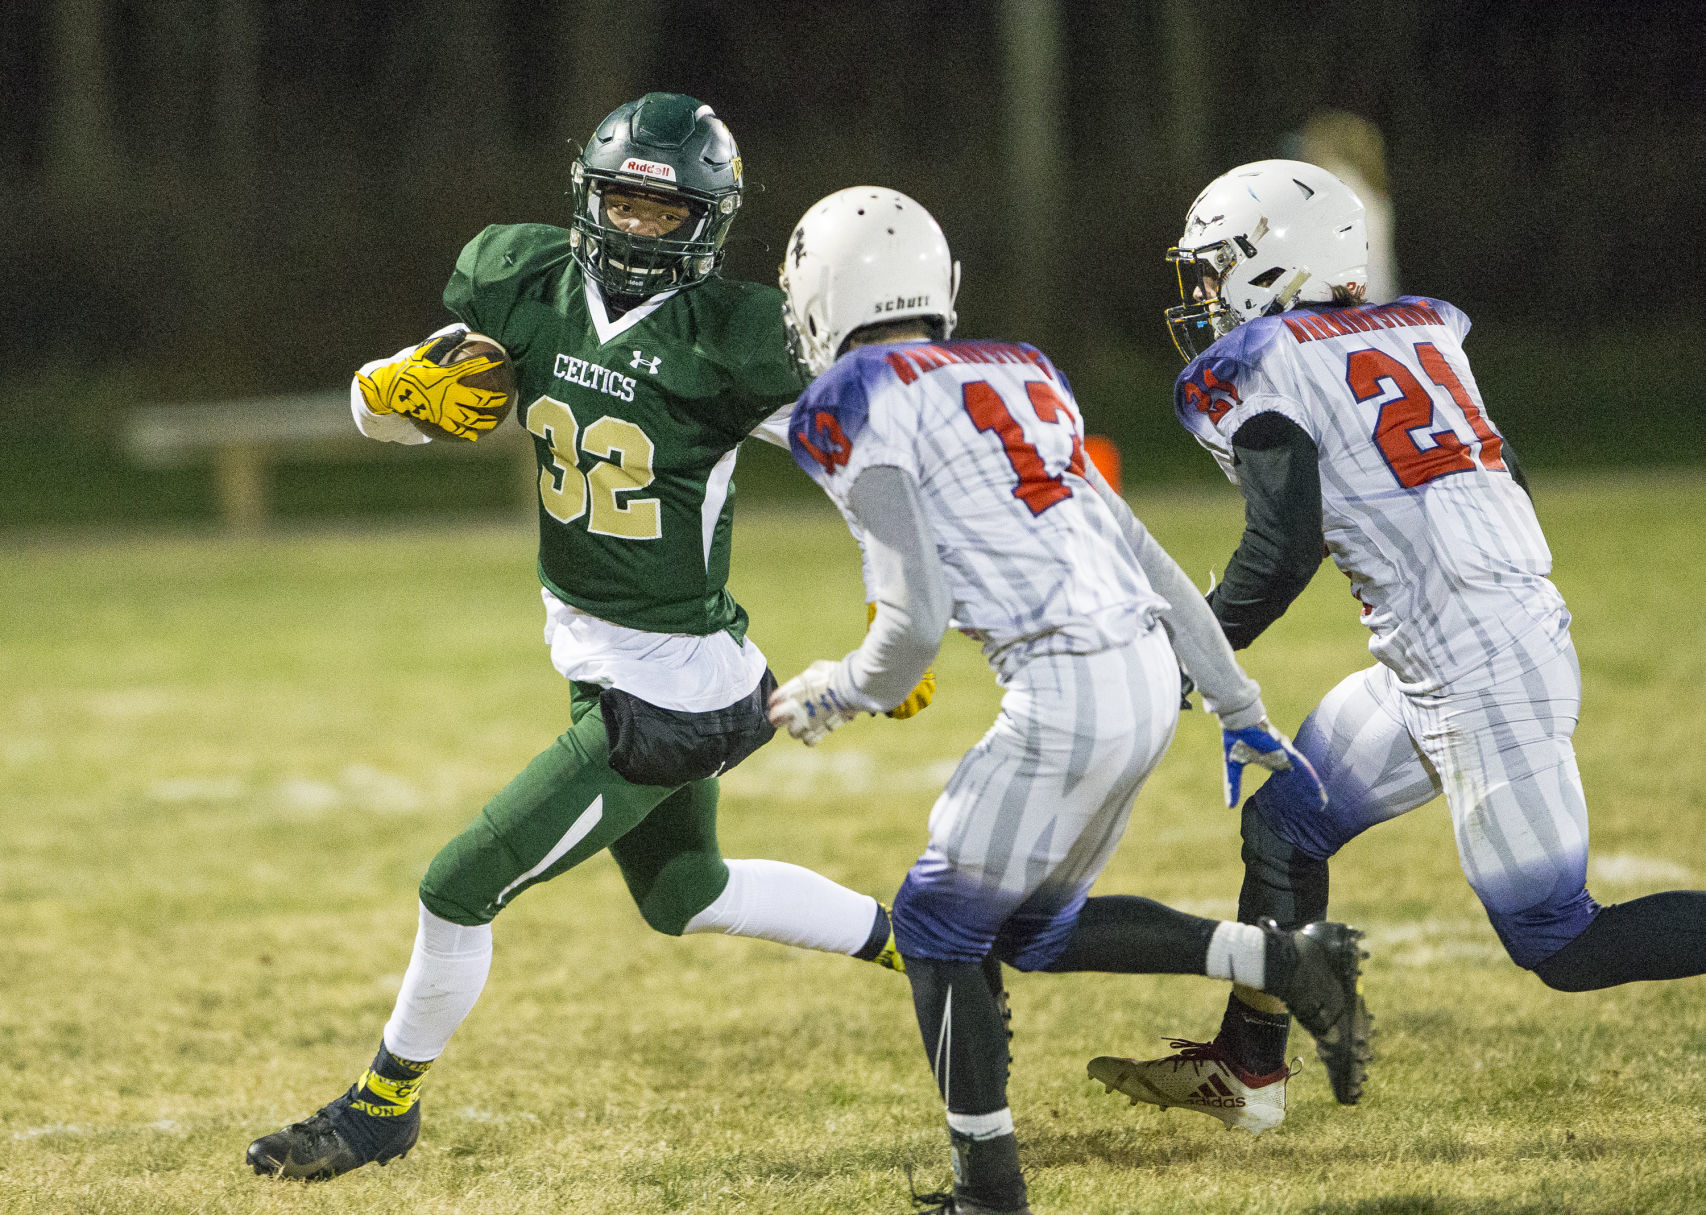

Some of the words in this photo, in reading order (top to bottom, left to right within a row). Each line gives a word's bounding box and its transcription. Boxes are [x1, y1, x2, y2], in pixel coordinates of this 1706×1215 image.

[553, 353, 637, 403] CELTICS
[1344, 341, 1508, 489] 21
[526, 394, 663, 540] 32
